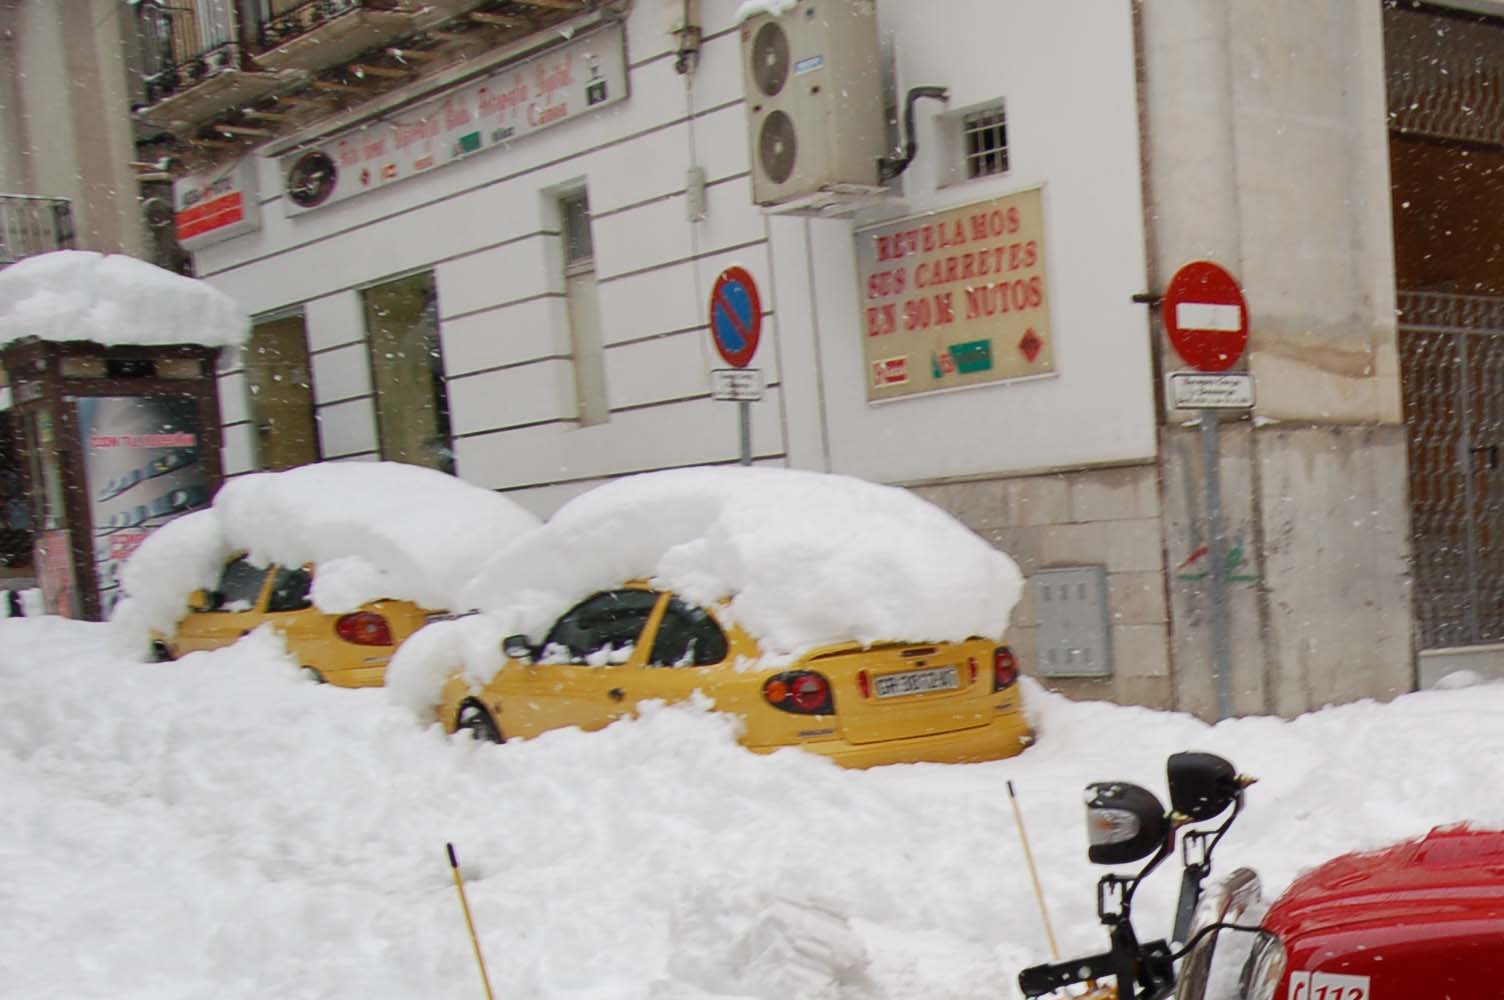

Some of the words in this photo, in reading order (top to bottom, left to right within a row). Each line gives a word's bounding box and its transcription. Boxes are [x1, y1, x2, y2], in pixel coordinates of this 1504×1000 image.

[876, 207, 1021, 262] REVELAMOS
[867, 266, 906, 299] SUS
[914, 240, 1038, 289] CARRETES
[866, 303, 897, 337] EN
